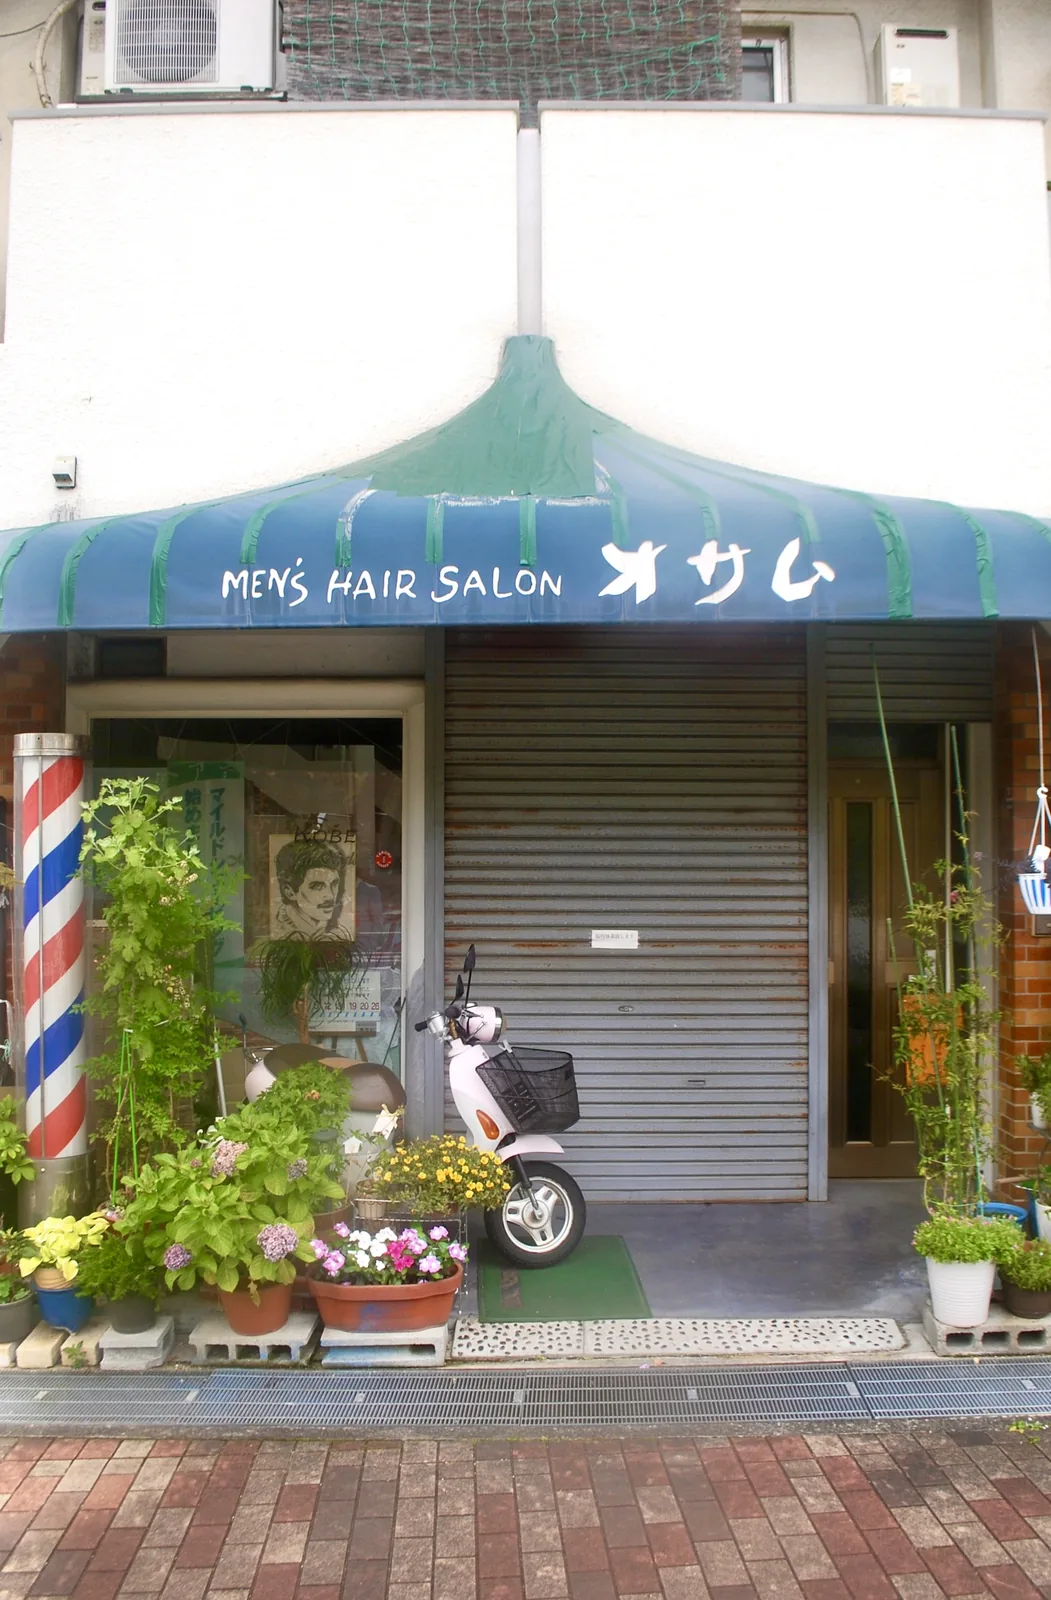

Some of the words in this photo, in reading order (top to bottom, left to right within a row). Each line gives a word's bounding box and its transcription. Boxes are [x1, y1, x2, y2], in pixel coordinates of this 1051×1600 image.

[326, 569, 417, 603] HAIR
[430, 565, 563, 603] SALON
[598, 537, 836, 607] オサム
[349, 1002, 357, 1010] 19
[360, 1002, 369, 1010] 20
[371, 1002, 380, 1010] 26
